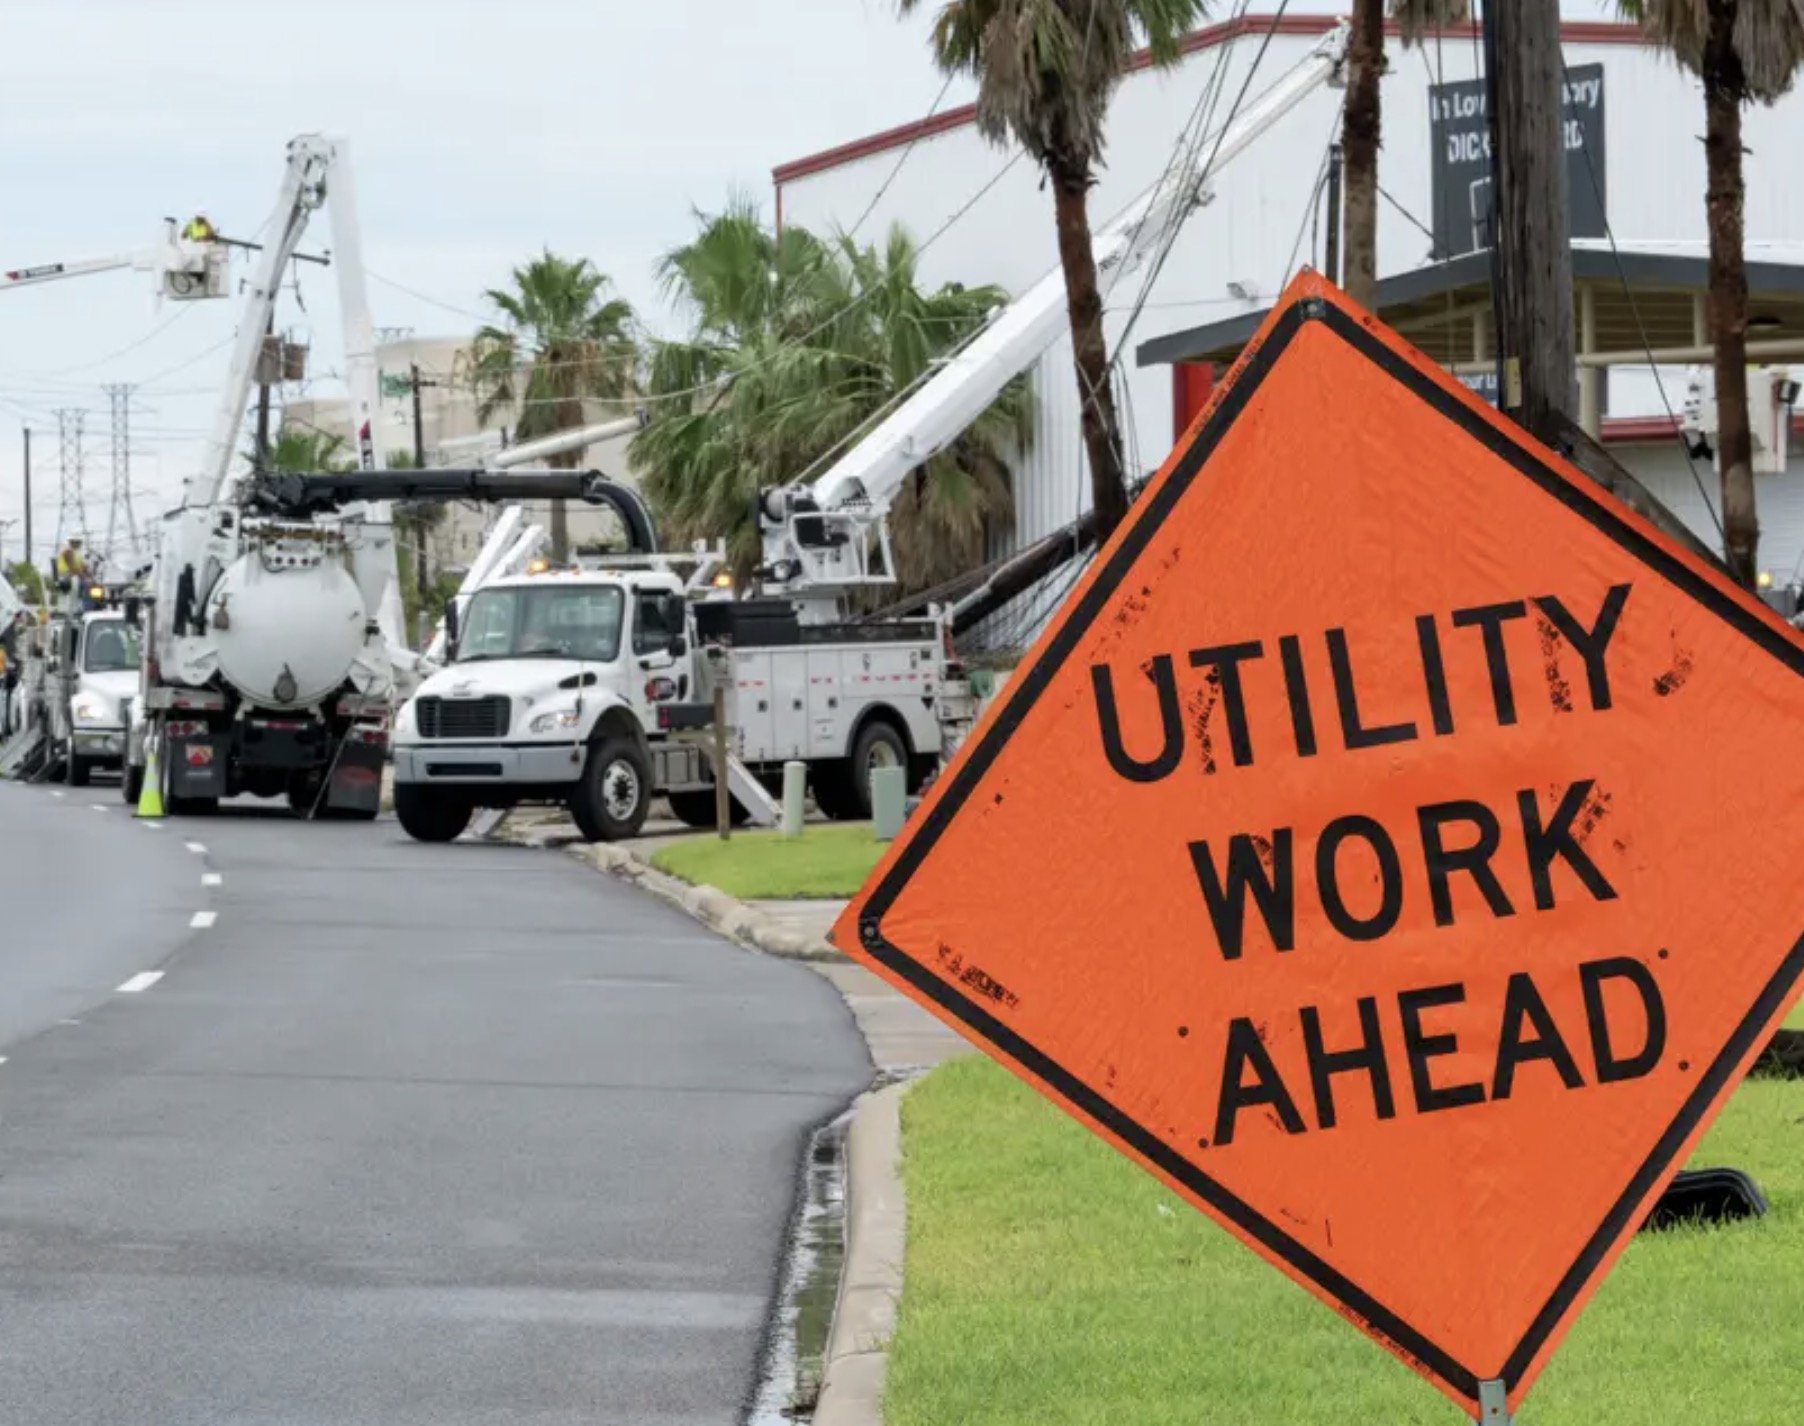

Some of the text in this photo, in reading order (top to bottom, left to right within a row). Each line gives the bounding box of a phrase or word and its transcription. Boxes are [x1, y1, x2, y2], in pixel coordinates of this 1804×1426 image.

[1091, 583, 1632, 783] UTILITY
[1188, 779, 1618, 961] WORK
[1212, 956, 1667, 1146] AHEAD
